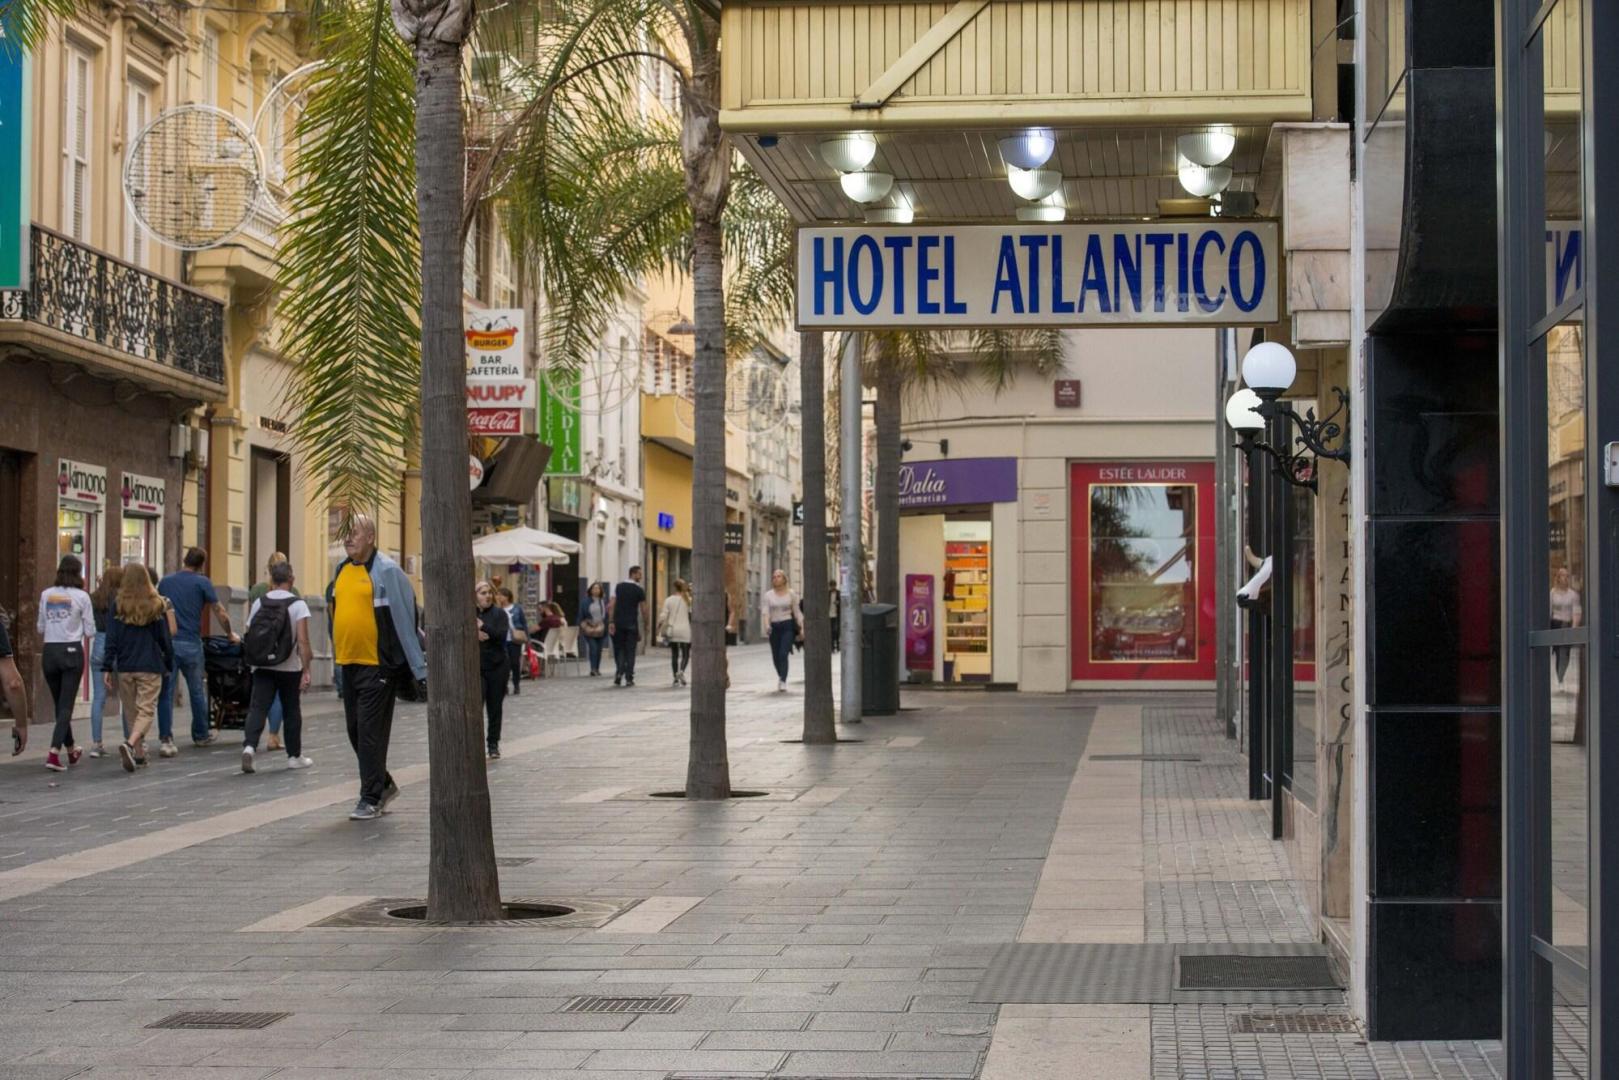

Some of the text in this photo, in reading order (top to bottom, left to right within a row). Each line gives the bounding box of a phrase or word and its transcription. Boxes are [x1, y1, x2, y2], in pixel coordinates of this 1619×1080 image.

[813, 230, 1267, 316] HOTEL ATLANTICO
[474, 339, 508, 347] BURGER
[480, 355, 502, 365] BAR
[68, 461, 107, 495] kimono
[899, 466, 946, 495] Dalia
[1099, 467, 1187, 480] ESTÉE LAUDER
[131, 475, 165, 506] kimono
